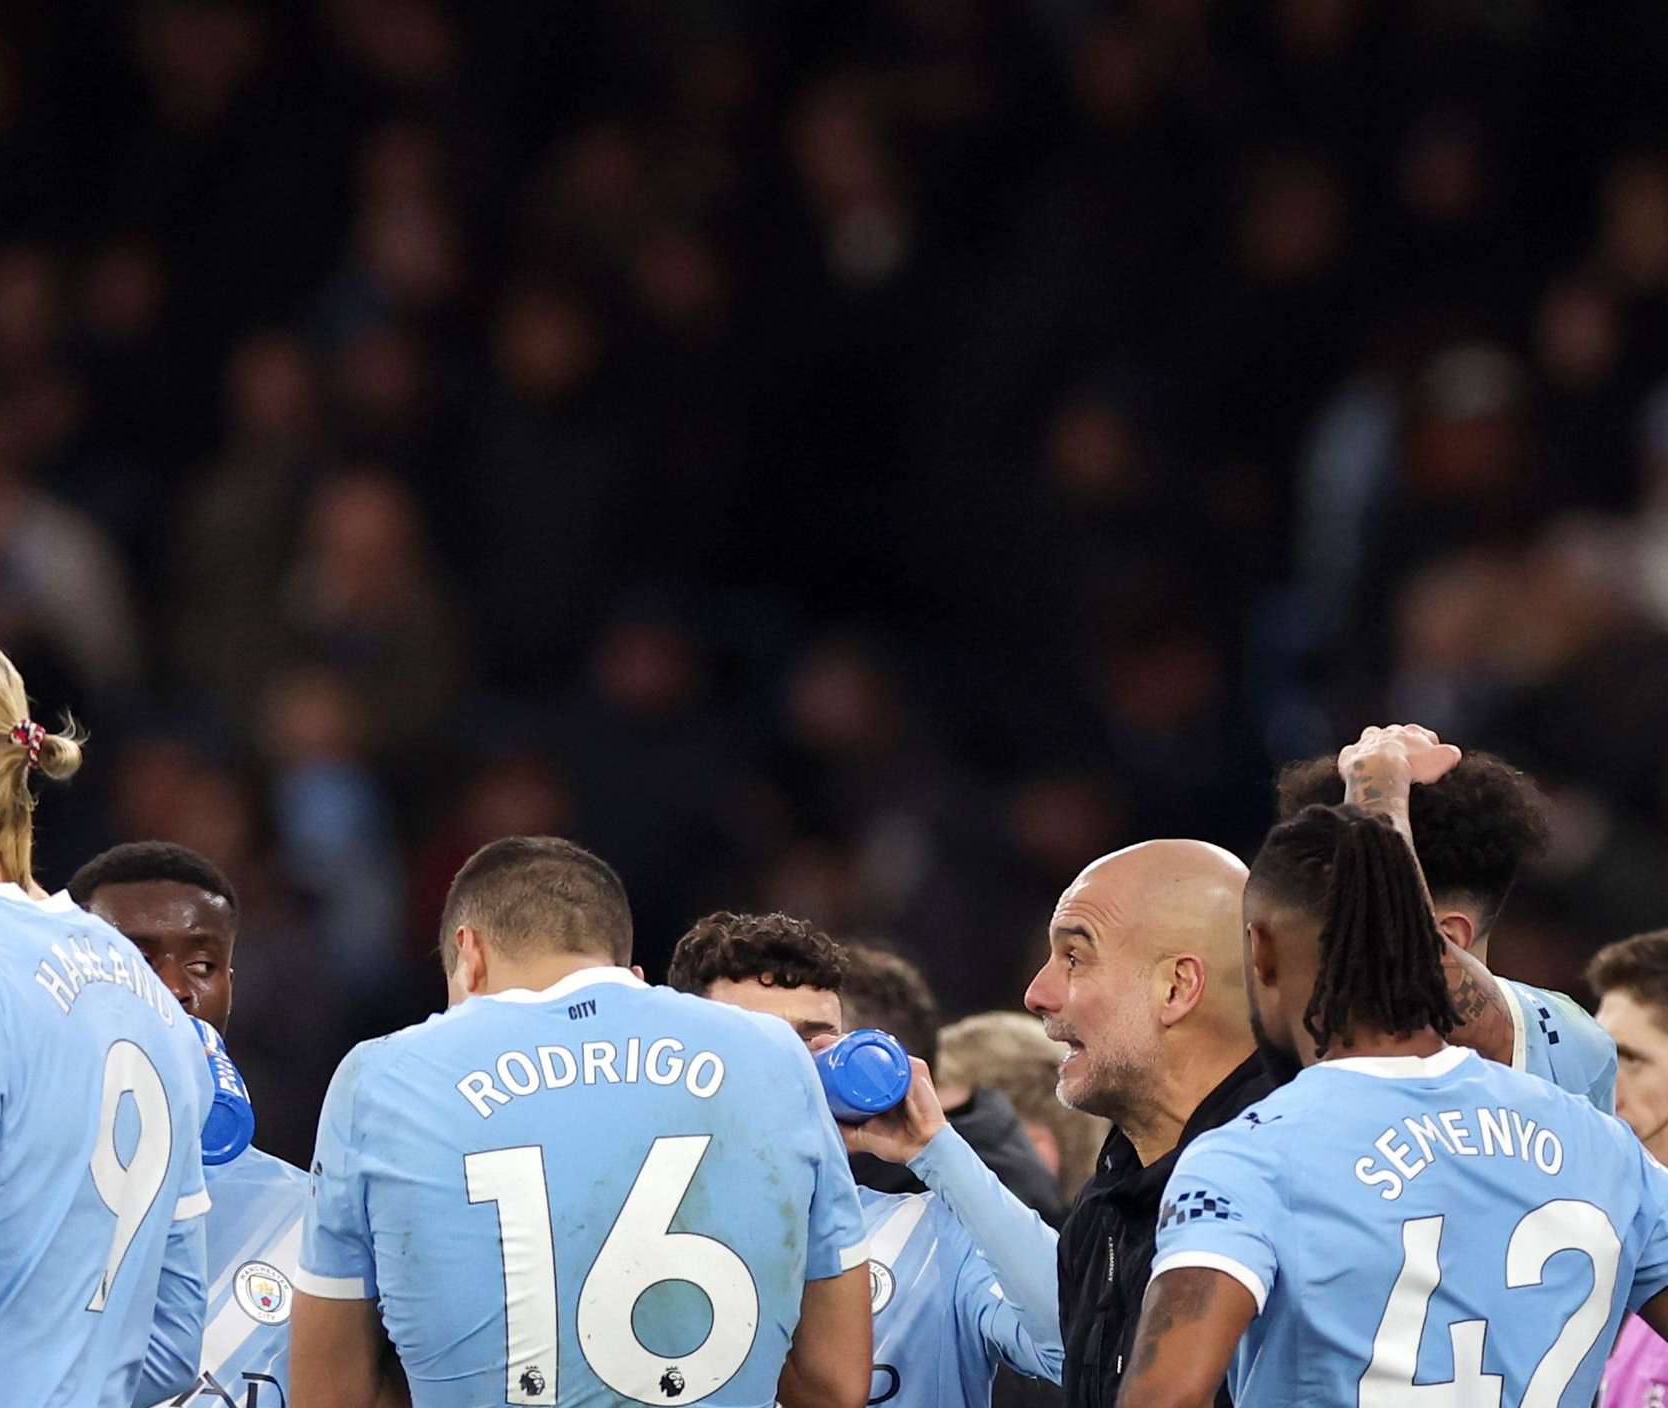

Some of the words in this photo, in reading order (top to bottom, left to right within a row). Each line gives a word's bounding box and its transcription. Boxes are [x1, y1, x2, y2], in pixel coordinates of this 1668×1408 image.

[568, 999, 597, 1021] CITY
[455, 1036, 725, 1120] RODRIGO
[85, 1038, 173, 1313] 9
[1354, 1106, 1564, 1202] SEMENYO
[463, 1134, 760, 1407] 16
[257, 1312, 276, 1321] CITY
